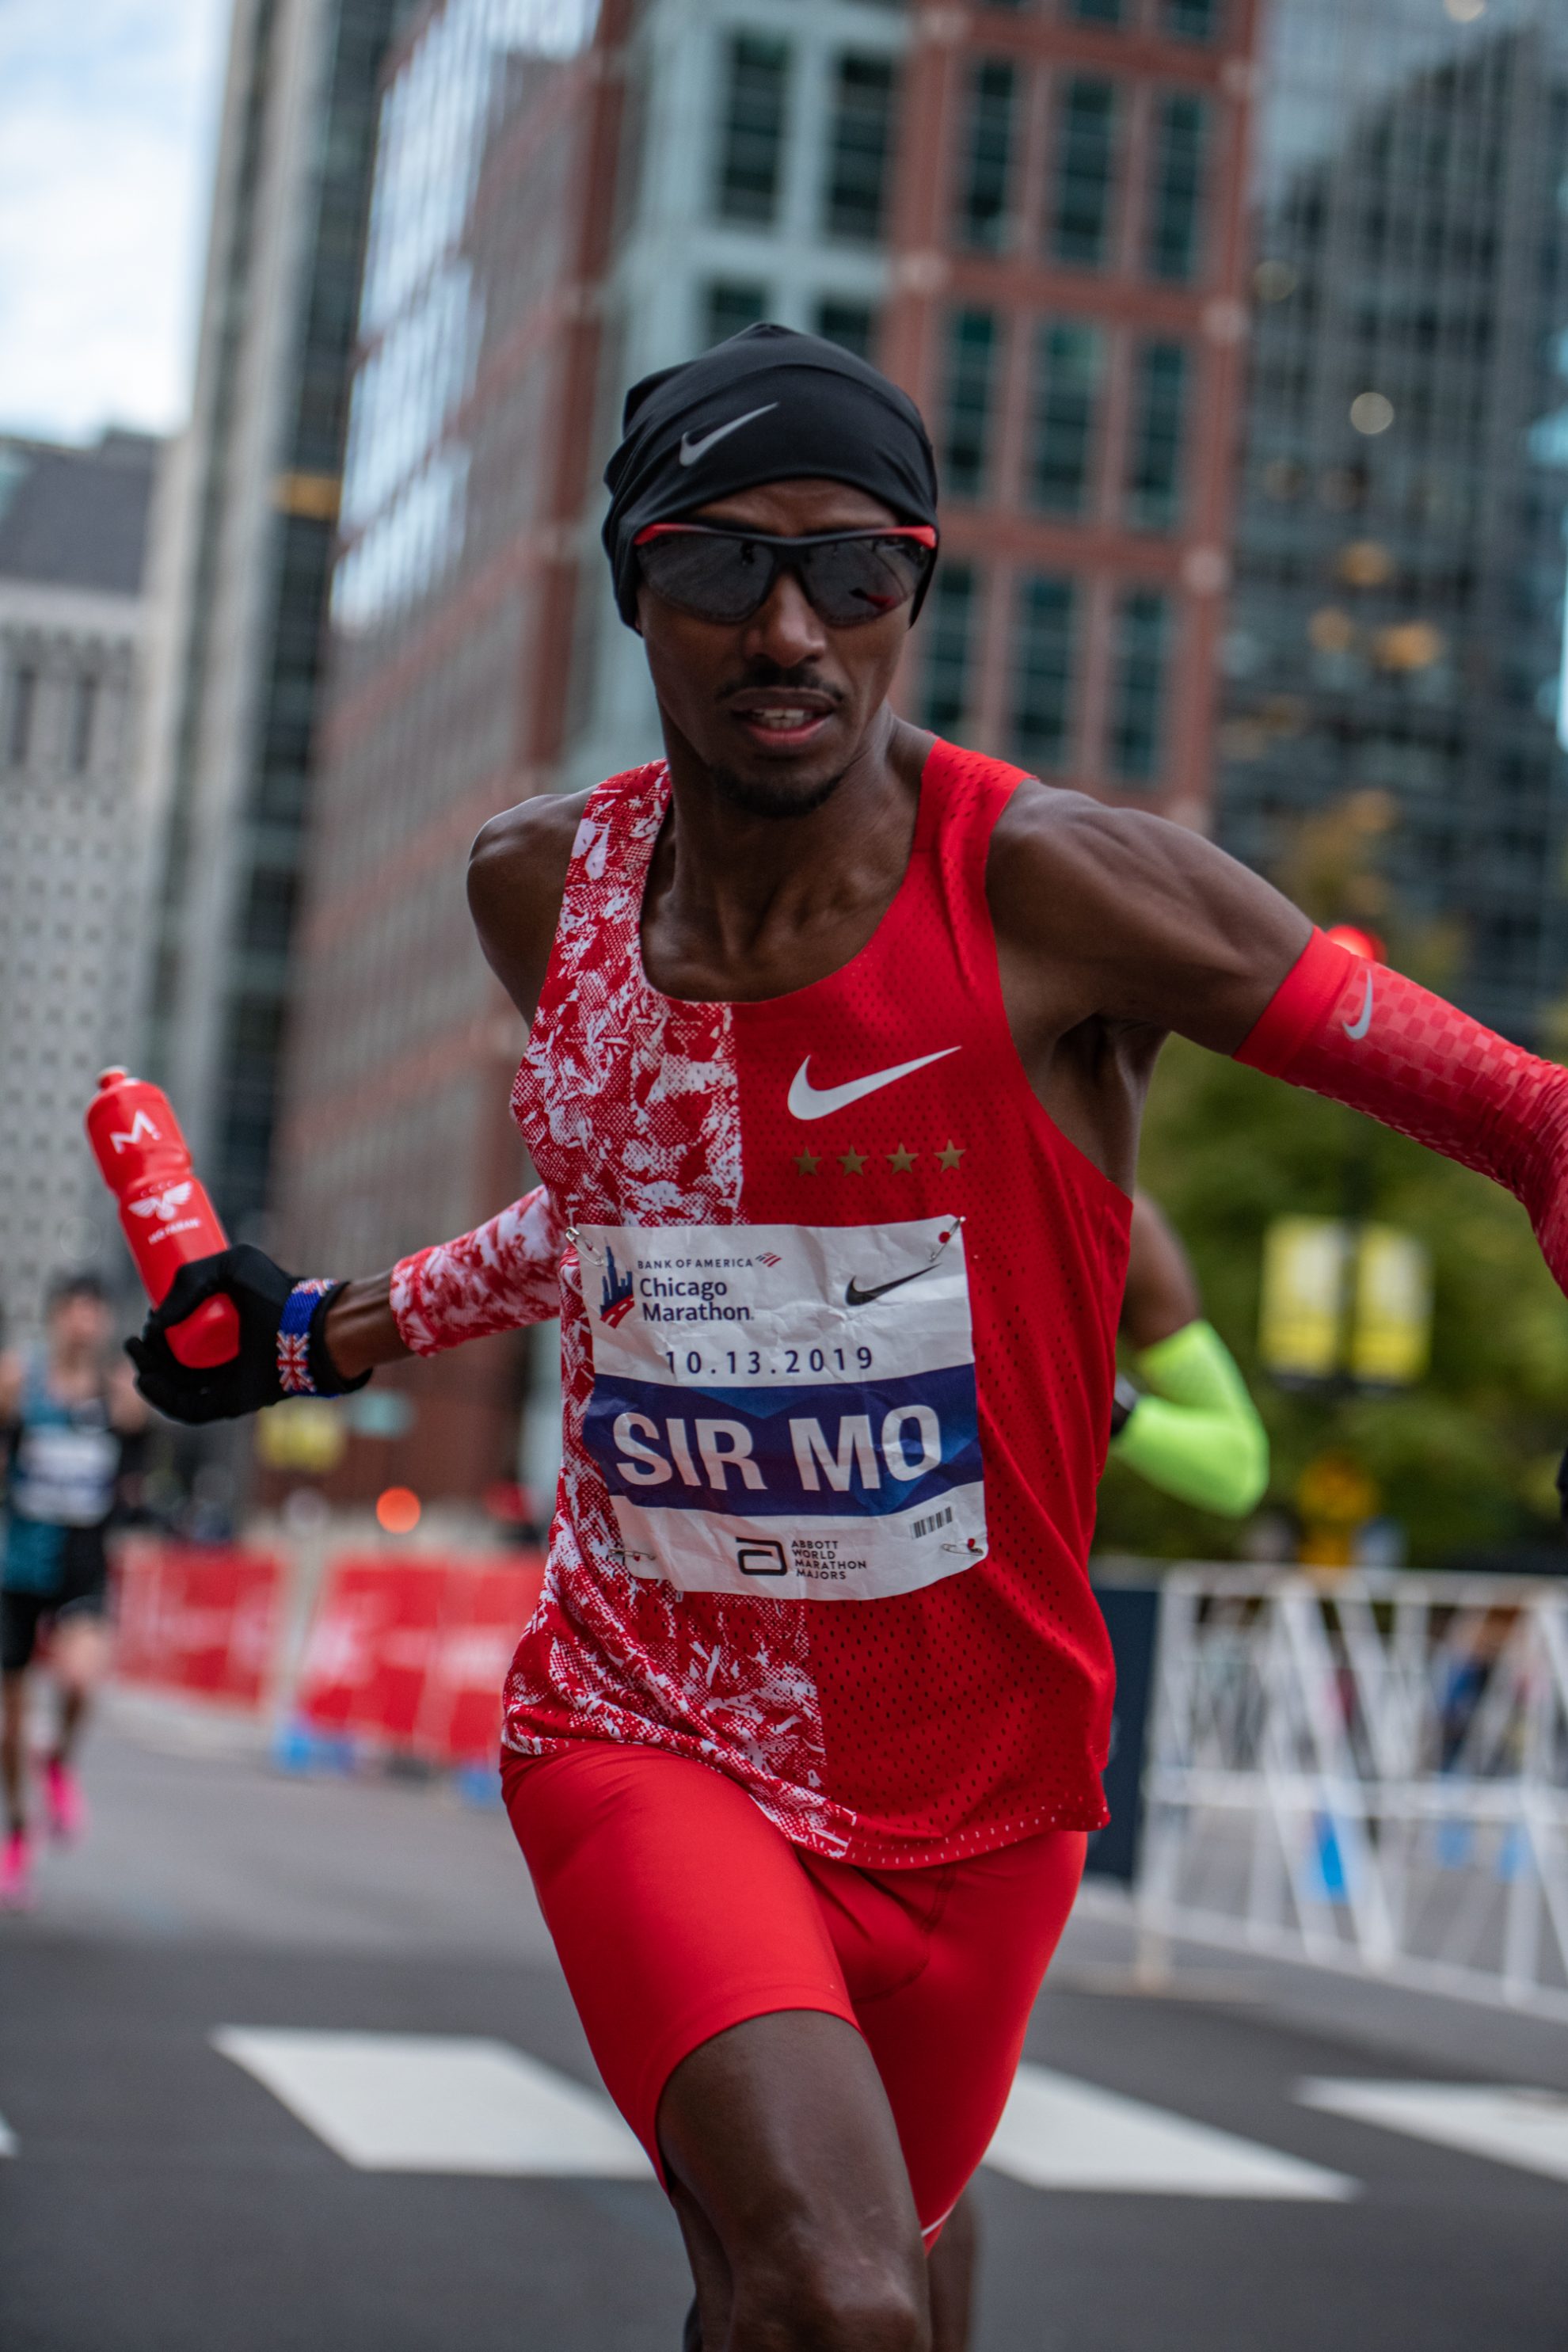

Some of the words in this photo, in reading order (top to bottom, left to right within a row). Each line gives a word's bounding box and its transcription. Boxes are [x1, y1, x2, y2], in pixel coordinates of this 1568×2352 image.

[637, 1259, 672, 1269] BANK
[676, 1259, 692, 1268] OF
[695, 1258, 753, 1268] AMERICA
[640, 1277, 728, 1301] Chicago
[666, 1346, 872, 1375] 10.13.2019
[613, 1412, 768, 1490] SIR
[788, 1404, 942, 1492] MO
[791, 1540, 839, 1550] ABBOTT
[792, 1549, 835, 1559] WORLD
[794, 1558, 867, 1570] MARATHON
[796, 1568, 847, 1580] MAJORS
